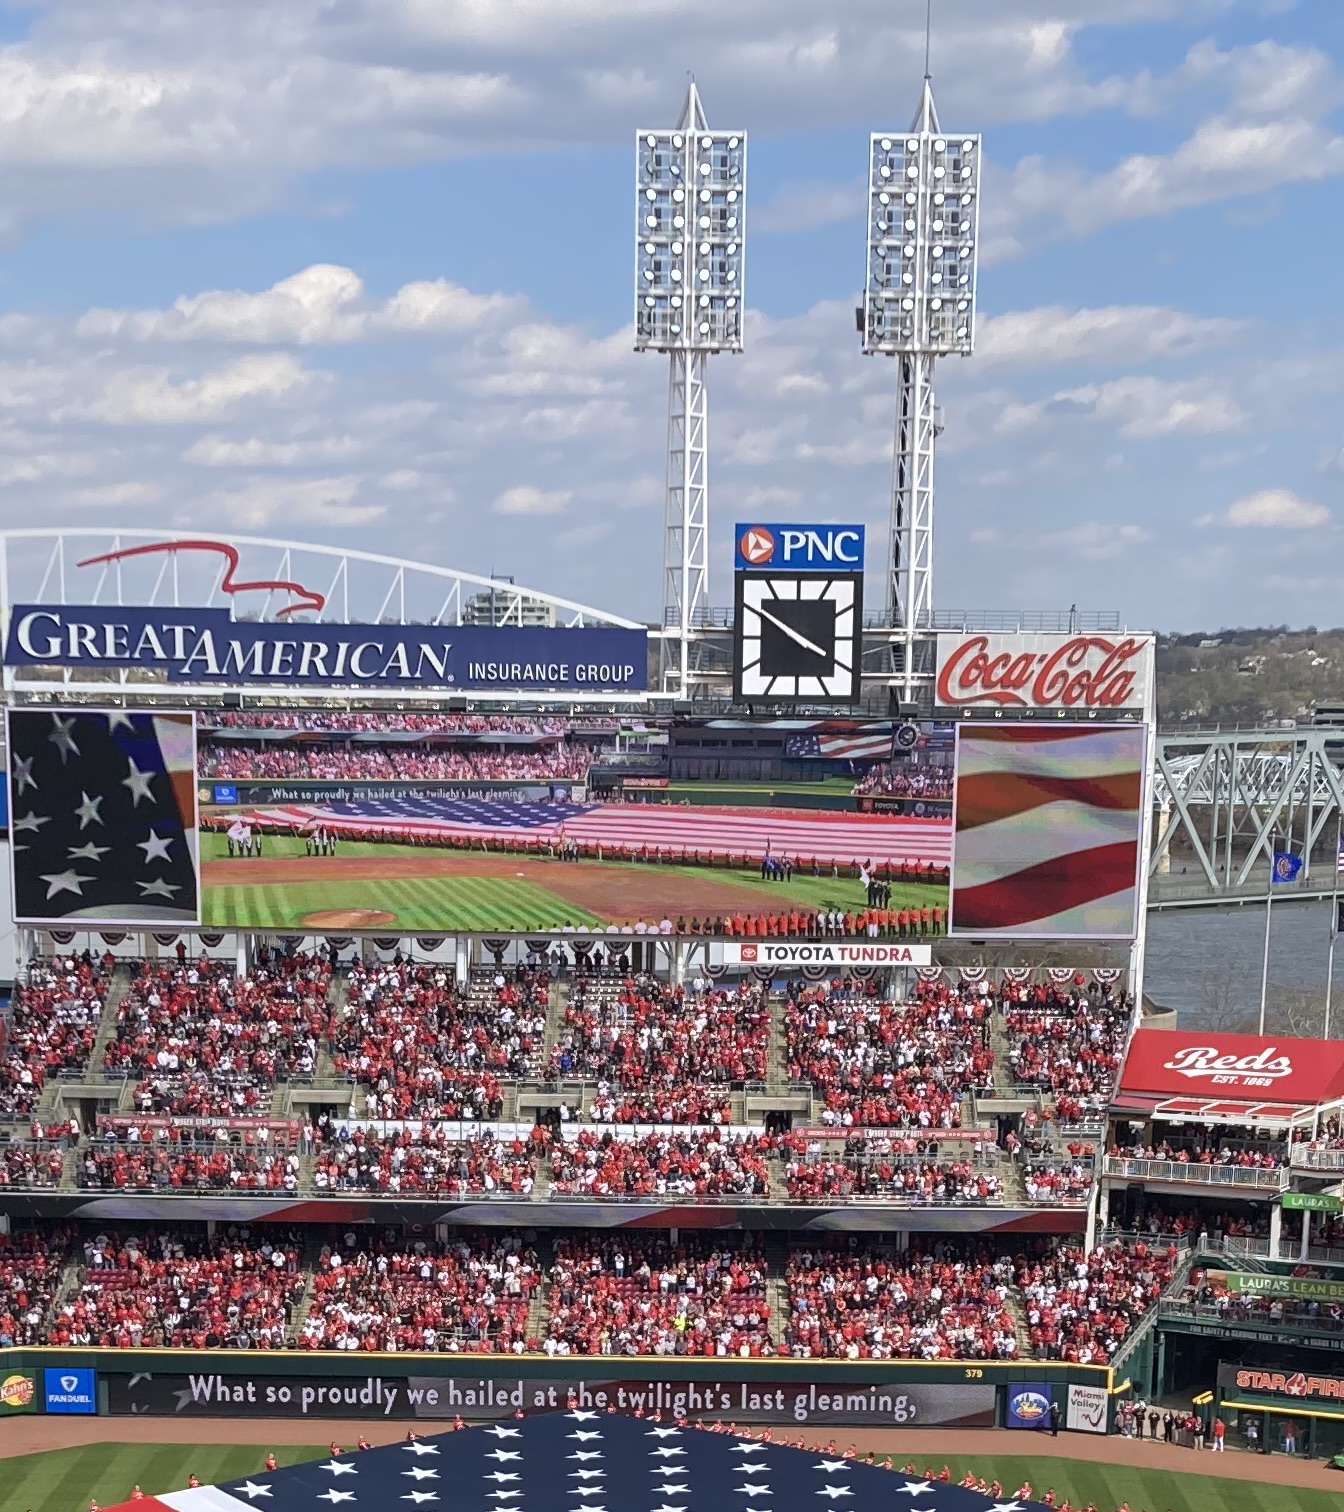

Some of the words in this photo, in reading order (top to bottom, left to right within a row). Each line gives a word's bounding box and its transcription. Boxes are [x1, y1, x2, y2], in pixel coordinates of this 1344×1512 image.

[779, 531, 859, 562] PNC
[468, 662, 570, 681] INSURANCE
[575, 664, 634, 682] GROUP
[272, 788, 299, 799] What
[314, 788, 350, 802] proudly
[764, 946, 834, 960] TOYOTA
[838, 947, 913, 961] TUNDRA
[1163, 1047, 1293, 1078] Reds
[1211, 1075, 1239, 1085] EST.
[1239, 1277, 1290, 1291] LAURA'S
[1293, 1282, 1326, 1294] LEAN
[965, 1369, 983, 1378] 379
[1236, 1370, 1286, 1391] STAR
[0, 1379, 33, 1401] Kahn's
[1073, 1388, 1105, 1400] Miami
[48, 1394, 91, 1403] FANDUEL
[189, 1375, 256, 1402] What
[265, 1384, 291, 1403] so
[301, 1377, 397, 1415] proudly
[407, 1387, 439, 1405] we
[449, 1379, 524, 1406] hailed
[533, 1385, 558, 1407] at
[567, 1381, 607, 1408] the
[617, 1382, 731, 1418] twilight's
[741, 1383, 785, 1411] last
[794, 1385, 917, 1422] gleaming,
[1070, 1398, 1102, 1413] Valley
